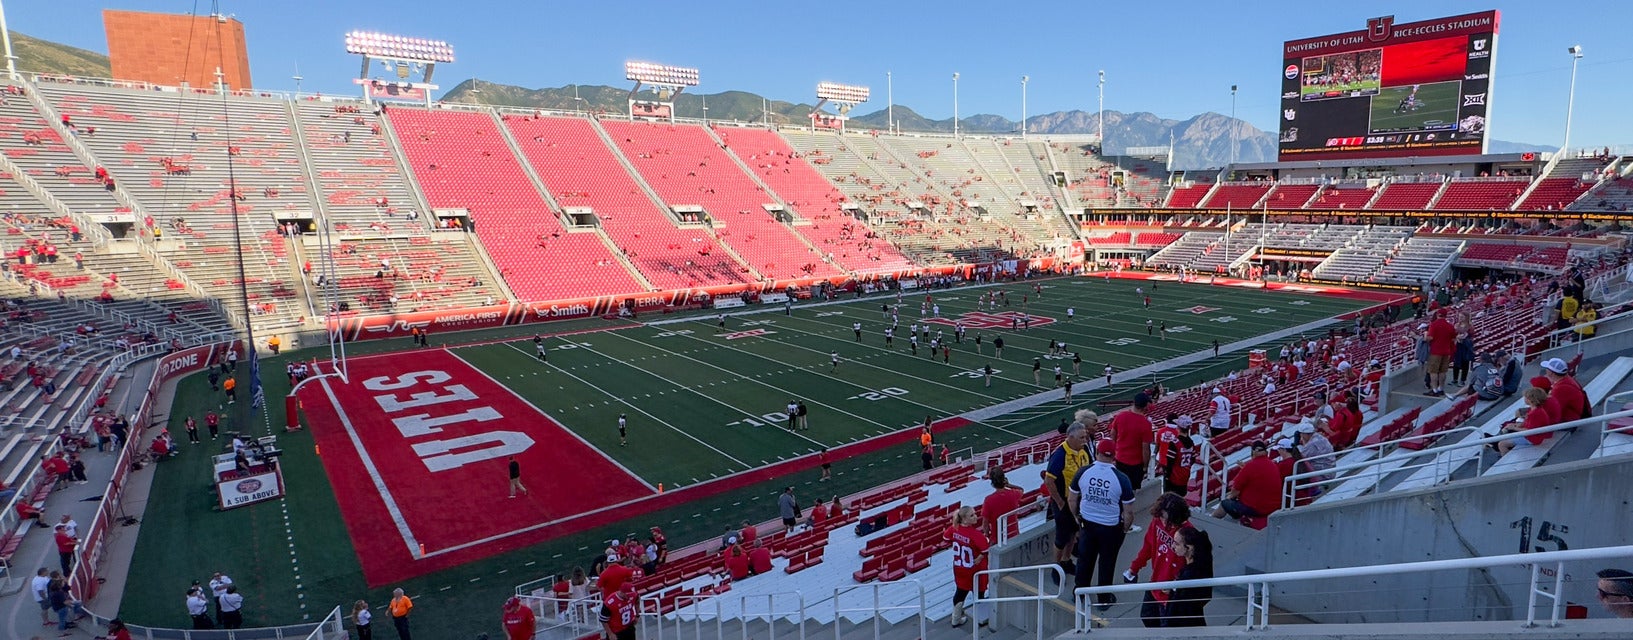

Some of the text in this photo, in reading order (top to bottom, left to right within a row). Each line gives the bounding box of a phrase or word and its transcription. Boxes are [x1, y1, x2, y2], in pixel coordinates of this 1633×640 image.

[1393, 17, 1491, 38] RICE-ECCLES STADIUM
[1287, 35, 1364, 53] UNIVERSITY OF UTAH
[434, 311, 502, 324] AMERICA FIRST
[551, 304, 589, 317] Smith's
[169, 353, 198, 373] ZONE
[858, 387, 910, 401] 20
[361, 370, 535, 473] UTES
[743, 411, 793, 428] 10
[1180, 453, 1192, 468] 23
[1089, 477, 1111, 489] CSC
[227, 489, 275, 506] A SUB ABOVE
[1088, 486, 1109, 498] EVENT
[1510, 516, 1569, 553] 15
[952, 541, 975, 568] 20
